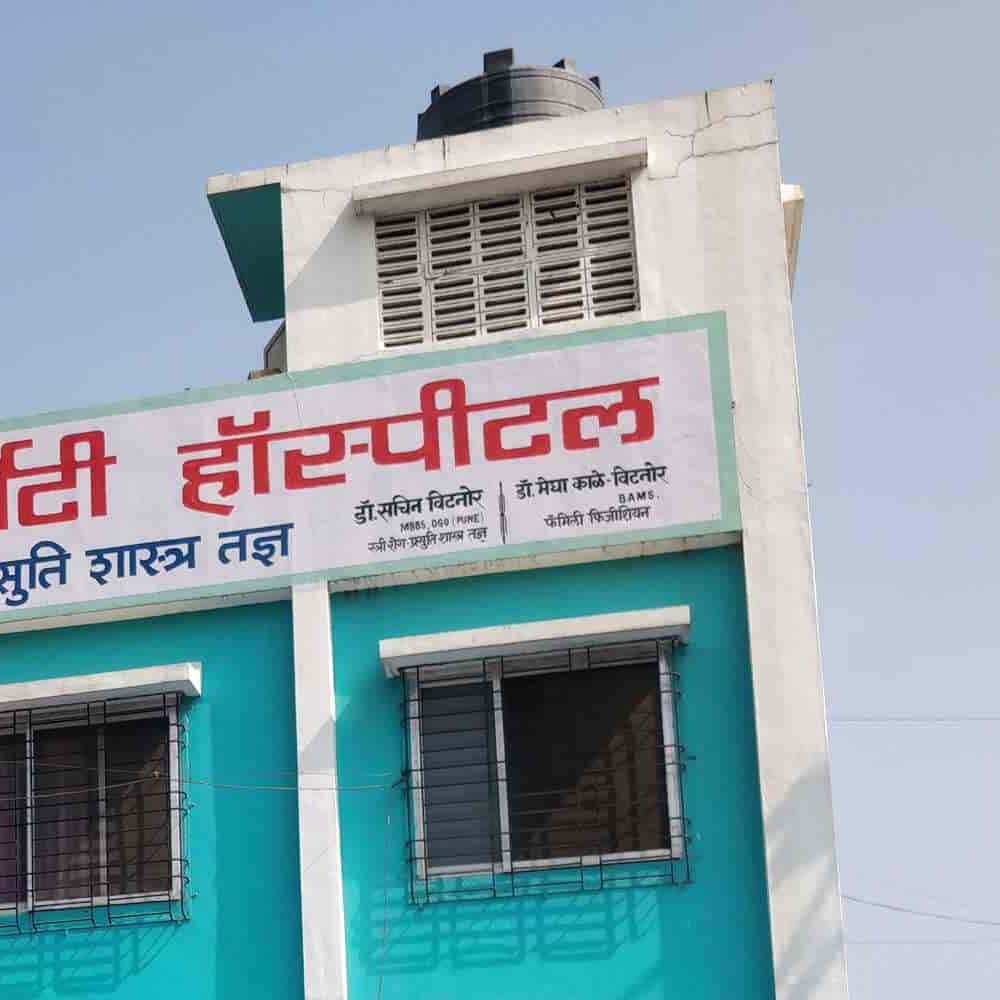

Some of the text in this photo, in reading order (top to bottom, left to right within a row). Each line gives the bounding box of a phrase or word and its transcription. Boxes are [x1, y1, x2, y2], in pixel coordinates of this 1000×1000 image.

[177, 376, 660, 517] हॉस्पीटल
[427, 485, 486, 513] विटनोर
[86, 535, 201, 586] शास्त्र
[217, 522, 295, 566] तज्ञ
